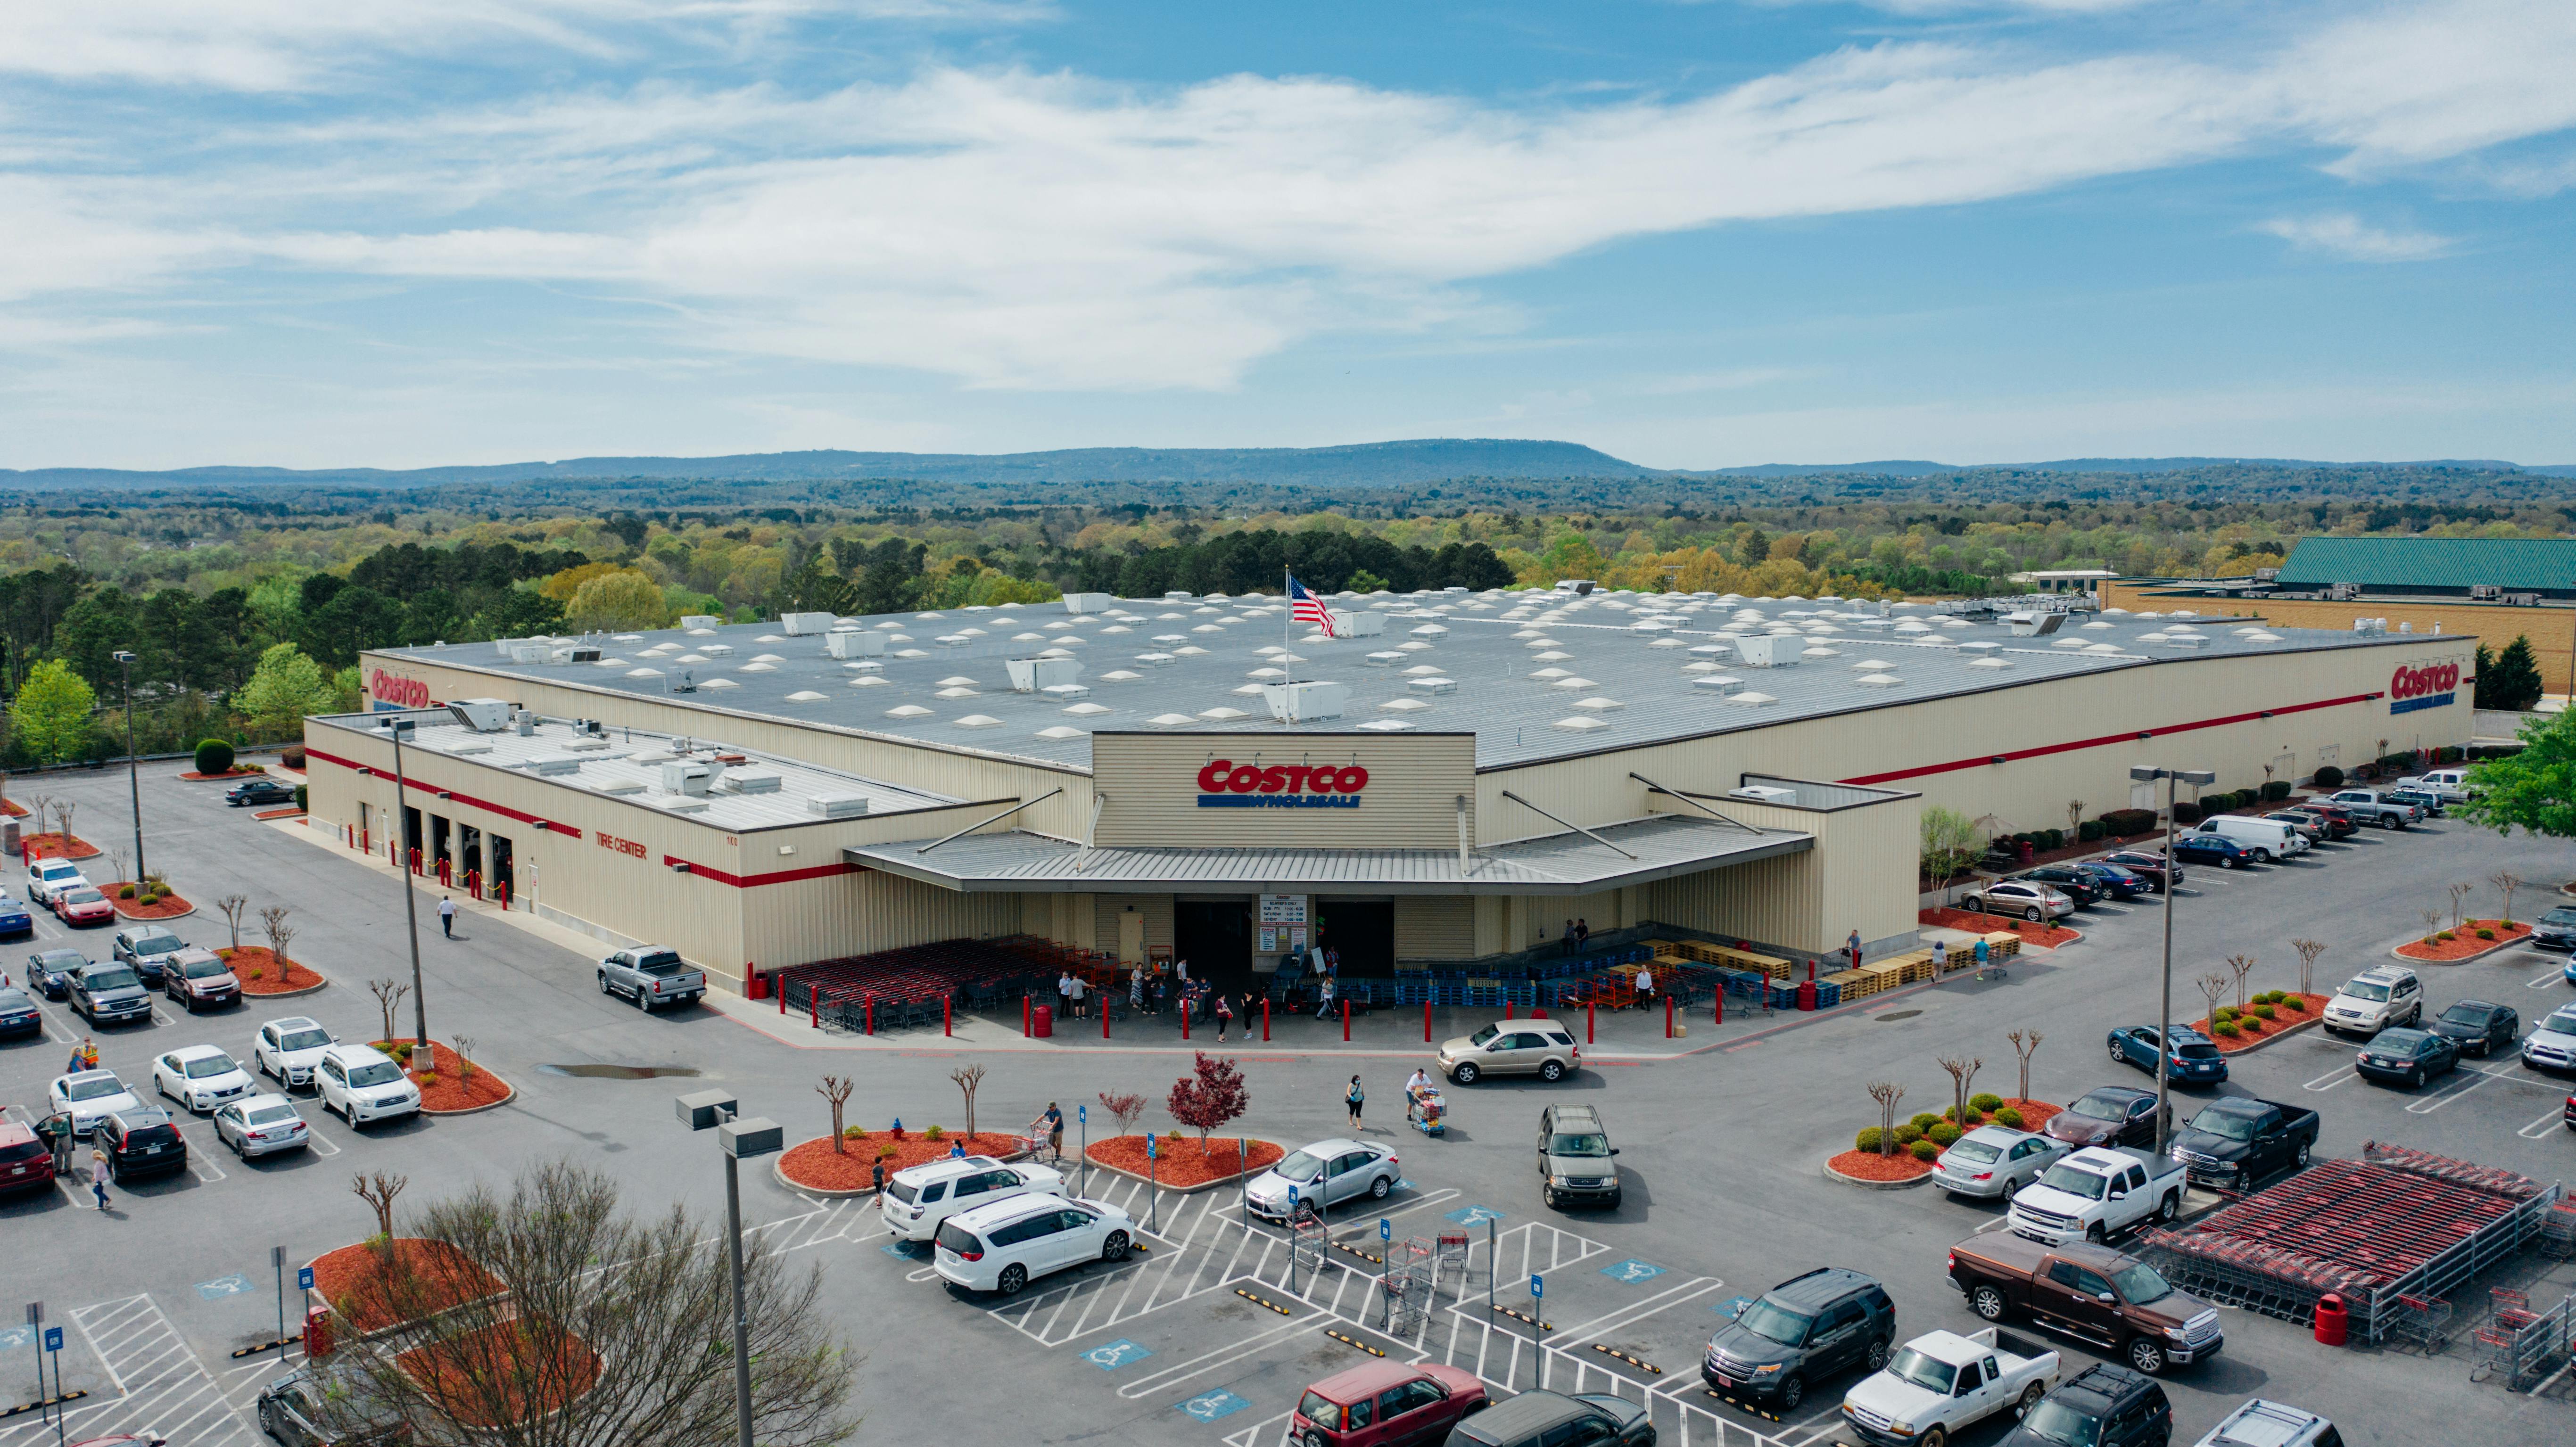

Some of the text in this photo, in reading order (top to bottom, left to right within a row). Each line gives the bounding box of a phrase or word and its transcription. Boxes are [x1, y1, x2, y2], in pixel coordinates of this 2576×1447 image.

[372, 668, 428, 708] COSTCO
[2392, 663, 2459, 699] COSTCO
[1197, 759, 1369, 793] COSTCO
[1248, 795, 1361, 807] WHOLESALE
[596, 831, 647, 860] TIRE CENTER
